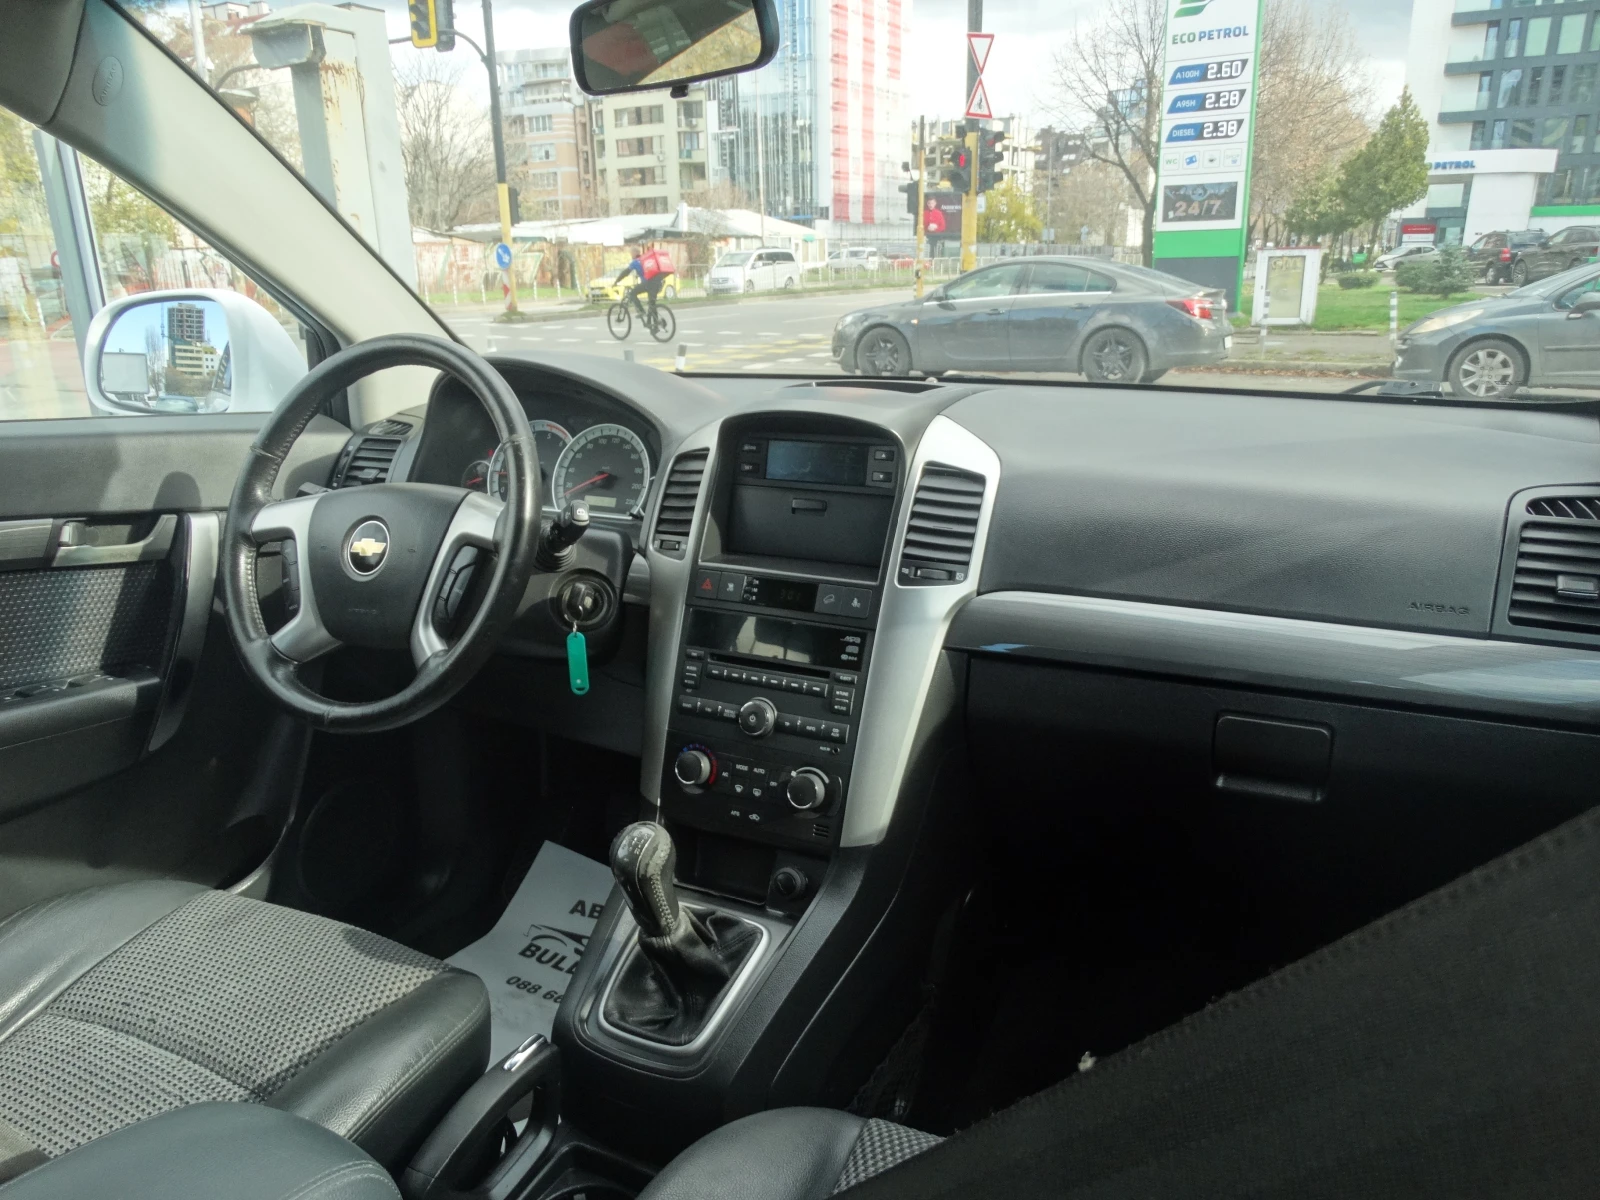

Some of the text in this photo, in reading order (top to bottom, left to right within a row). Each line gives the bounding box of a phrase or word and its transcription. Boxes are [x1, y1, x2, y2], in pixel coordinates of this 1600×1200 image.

[1171, 25, 1249, 45] ECO PETROL
[1207, 60, 1242, 79] 2.60
[1175, 90, 1240, 109] A95H 2.28
[1172, 120, 1238, 138] DIESEL 2.38
[1433, 160, 1476, 170] PETROL
[1174, 200, 1222, 217] 24/7
[598, 437, 608, 445] 100
[634, 467, 643, 475] 180
[1407, 601, 1470, 616] AIRBAG
[736, 764, 749, 772] MODE
[753, 767, 765, 775] AUTO
[505, 976, 543, 995] 088
